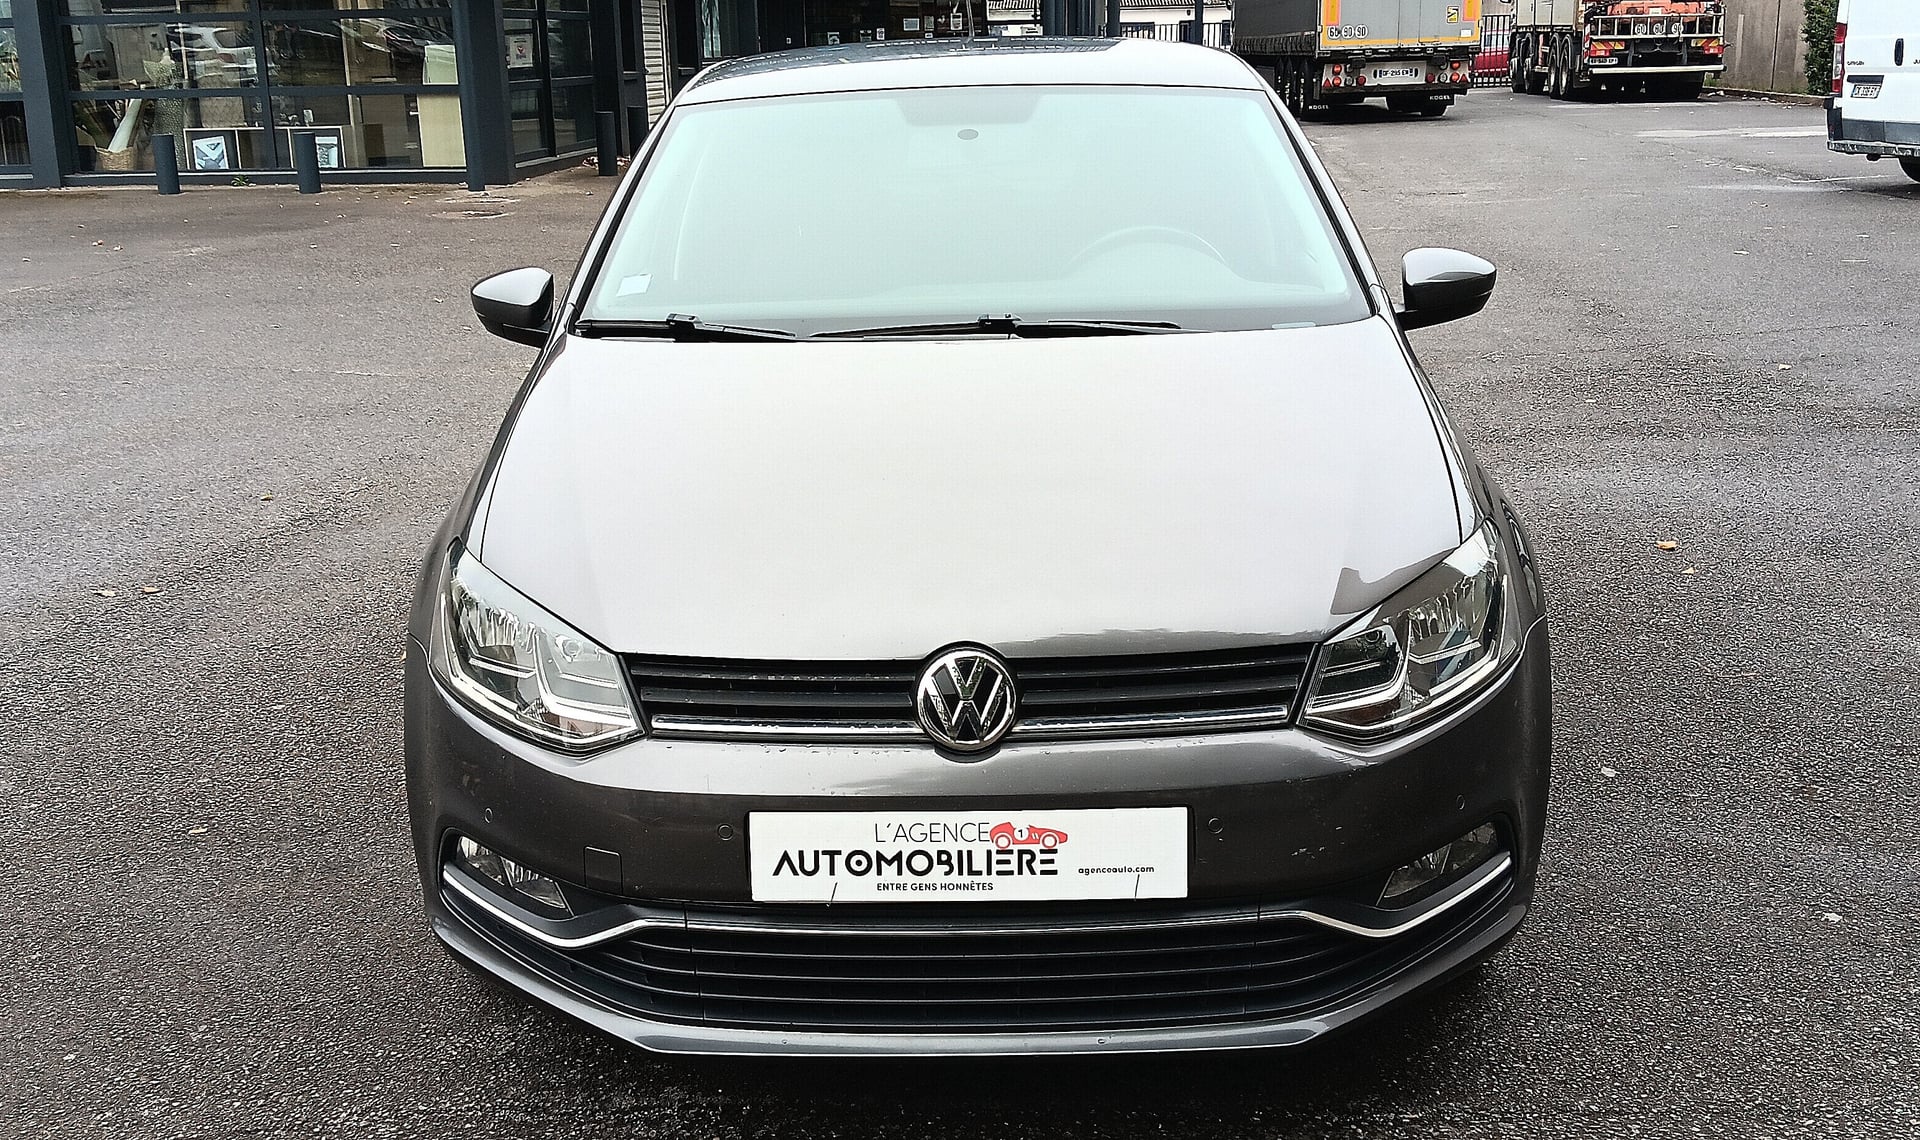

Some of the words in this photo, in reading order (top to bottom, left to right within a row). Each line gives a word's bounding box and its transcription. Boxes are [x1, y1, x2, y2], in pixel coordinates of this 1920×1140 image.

[874, 822, 990, 844] L'AGENCE
[876, 882, 908, 892] ENTRE
[910, 882, 938, 892] GENS
[940, 880, 994, 892] HONNÊTES
